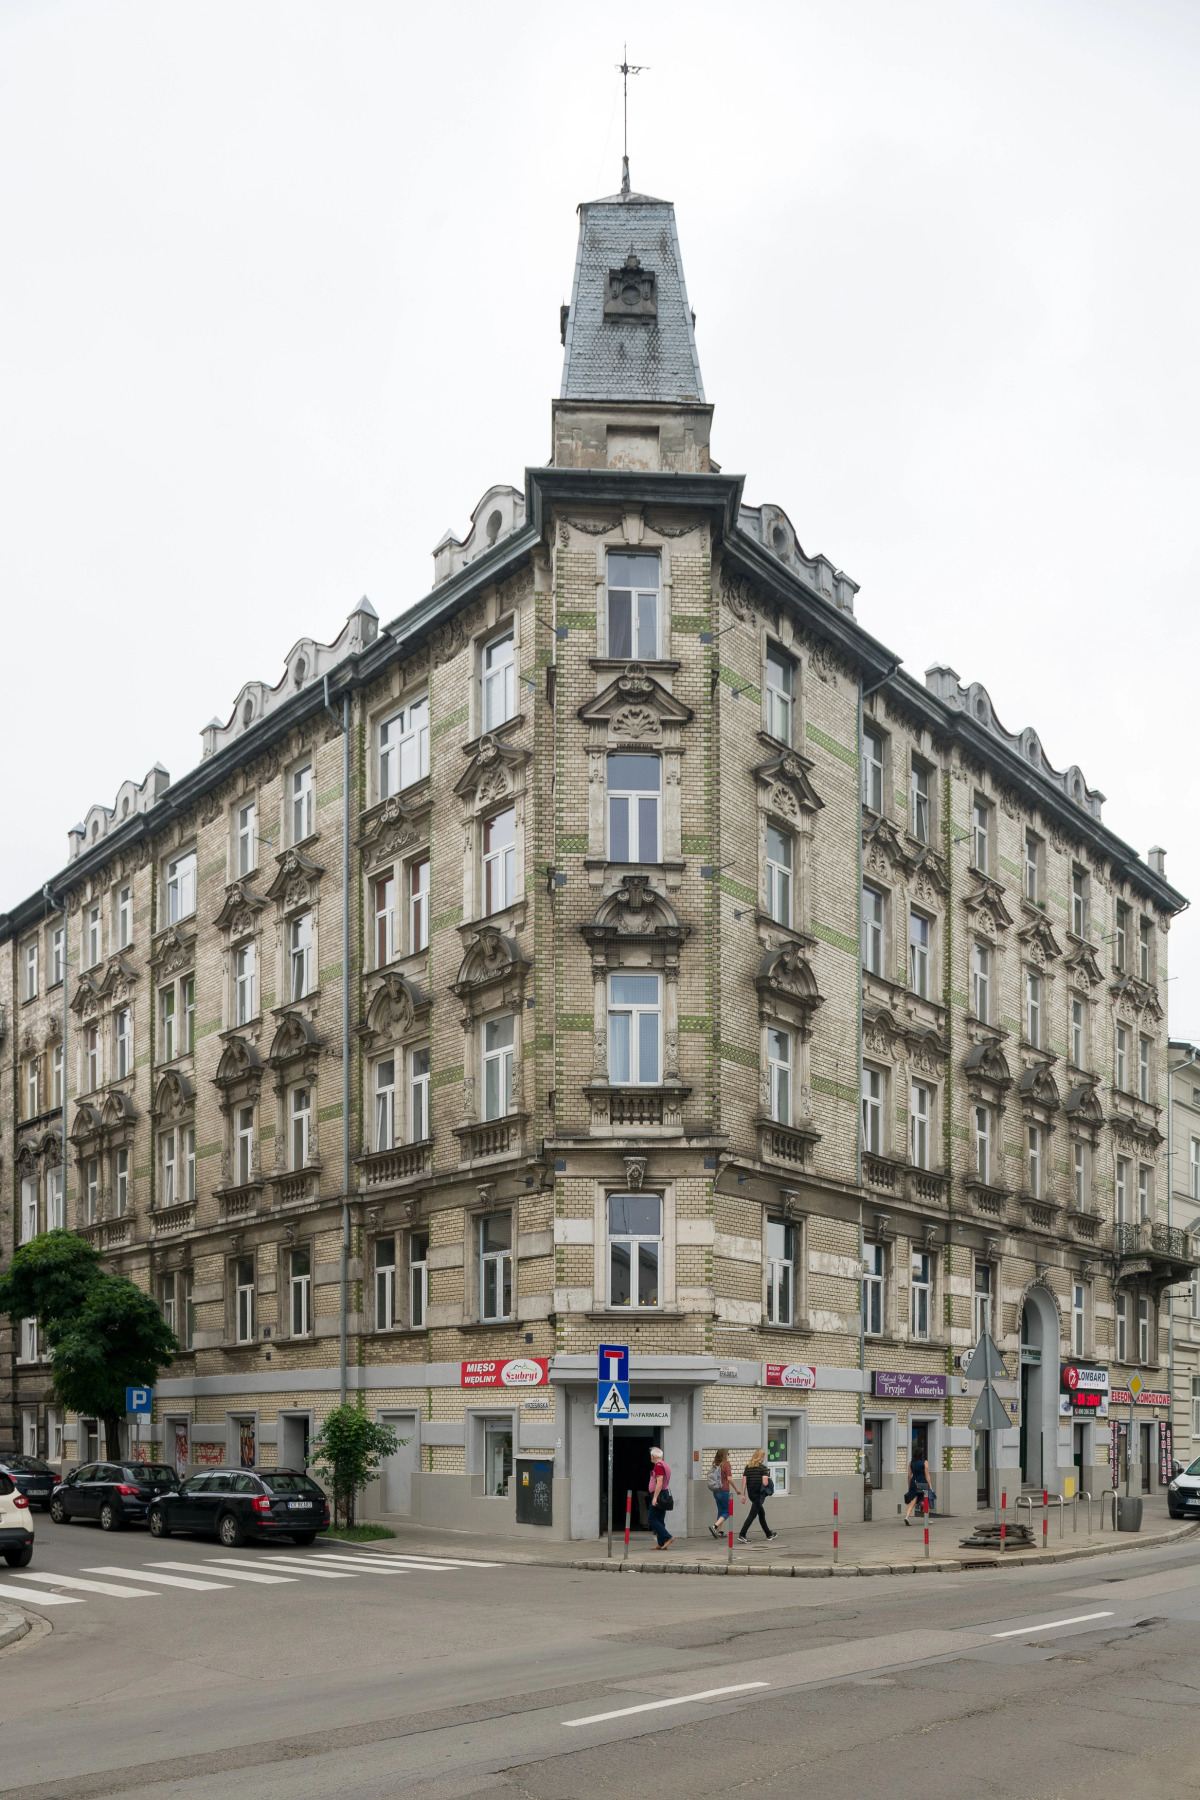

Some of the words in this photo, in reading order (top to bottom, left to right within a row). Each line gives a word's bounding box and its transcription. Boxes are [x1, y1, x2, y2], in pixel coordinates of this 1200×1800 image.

[466, 1363, 496, 1374] MIĘSO
[464, 1375, 497, 1385] WĘDLINY
[505, 1371, 538, 1382] Szubryt
[784, 1375, 811, 1387] Szubryt
[1078, 1371, 1106, 1382] LOMBARD
[884, 1383, 906, 1396] Fryzjer
[914, 1384, 944, 1397] Kosmetyka
[132, 1390, 147, 1409] P
[1111, 1390, 1132, 1403] ELEFON
